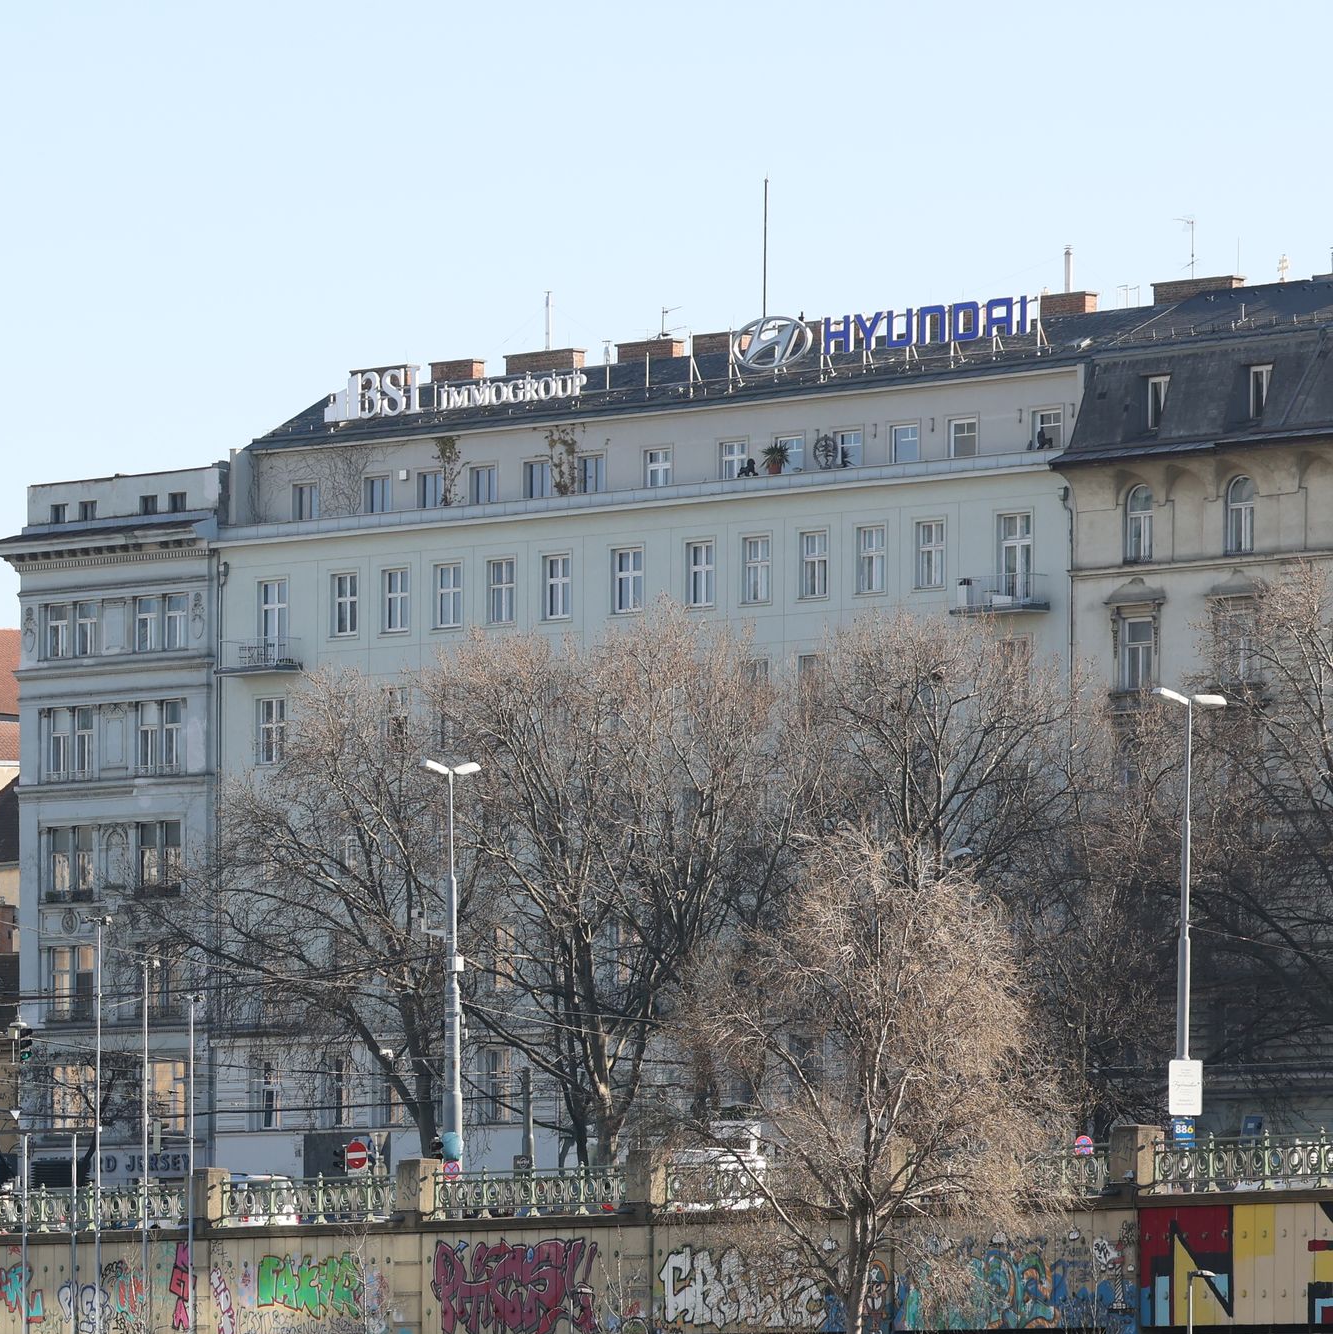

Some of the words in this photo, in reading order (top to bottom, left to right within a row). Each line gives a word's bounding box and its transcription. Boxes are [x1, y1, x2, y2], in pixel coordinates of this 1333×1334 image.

[824, 295, 1028, 356] HYUNDAI
[438, 372, 587, 412] IMMOGROUP
[1175, 1124, 1194, 1134] 886
